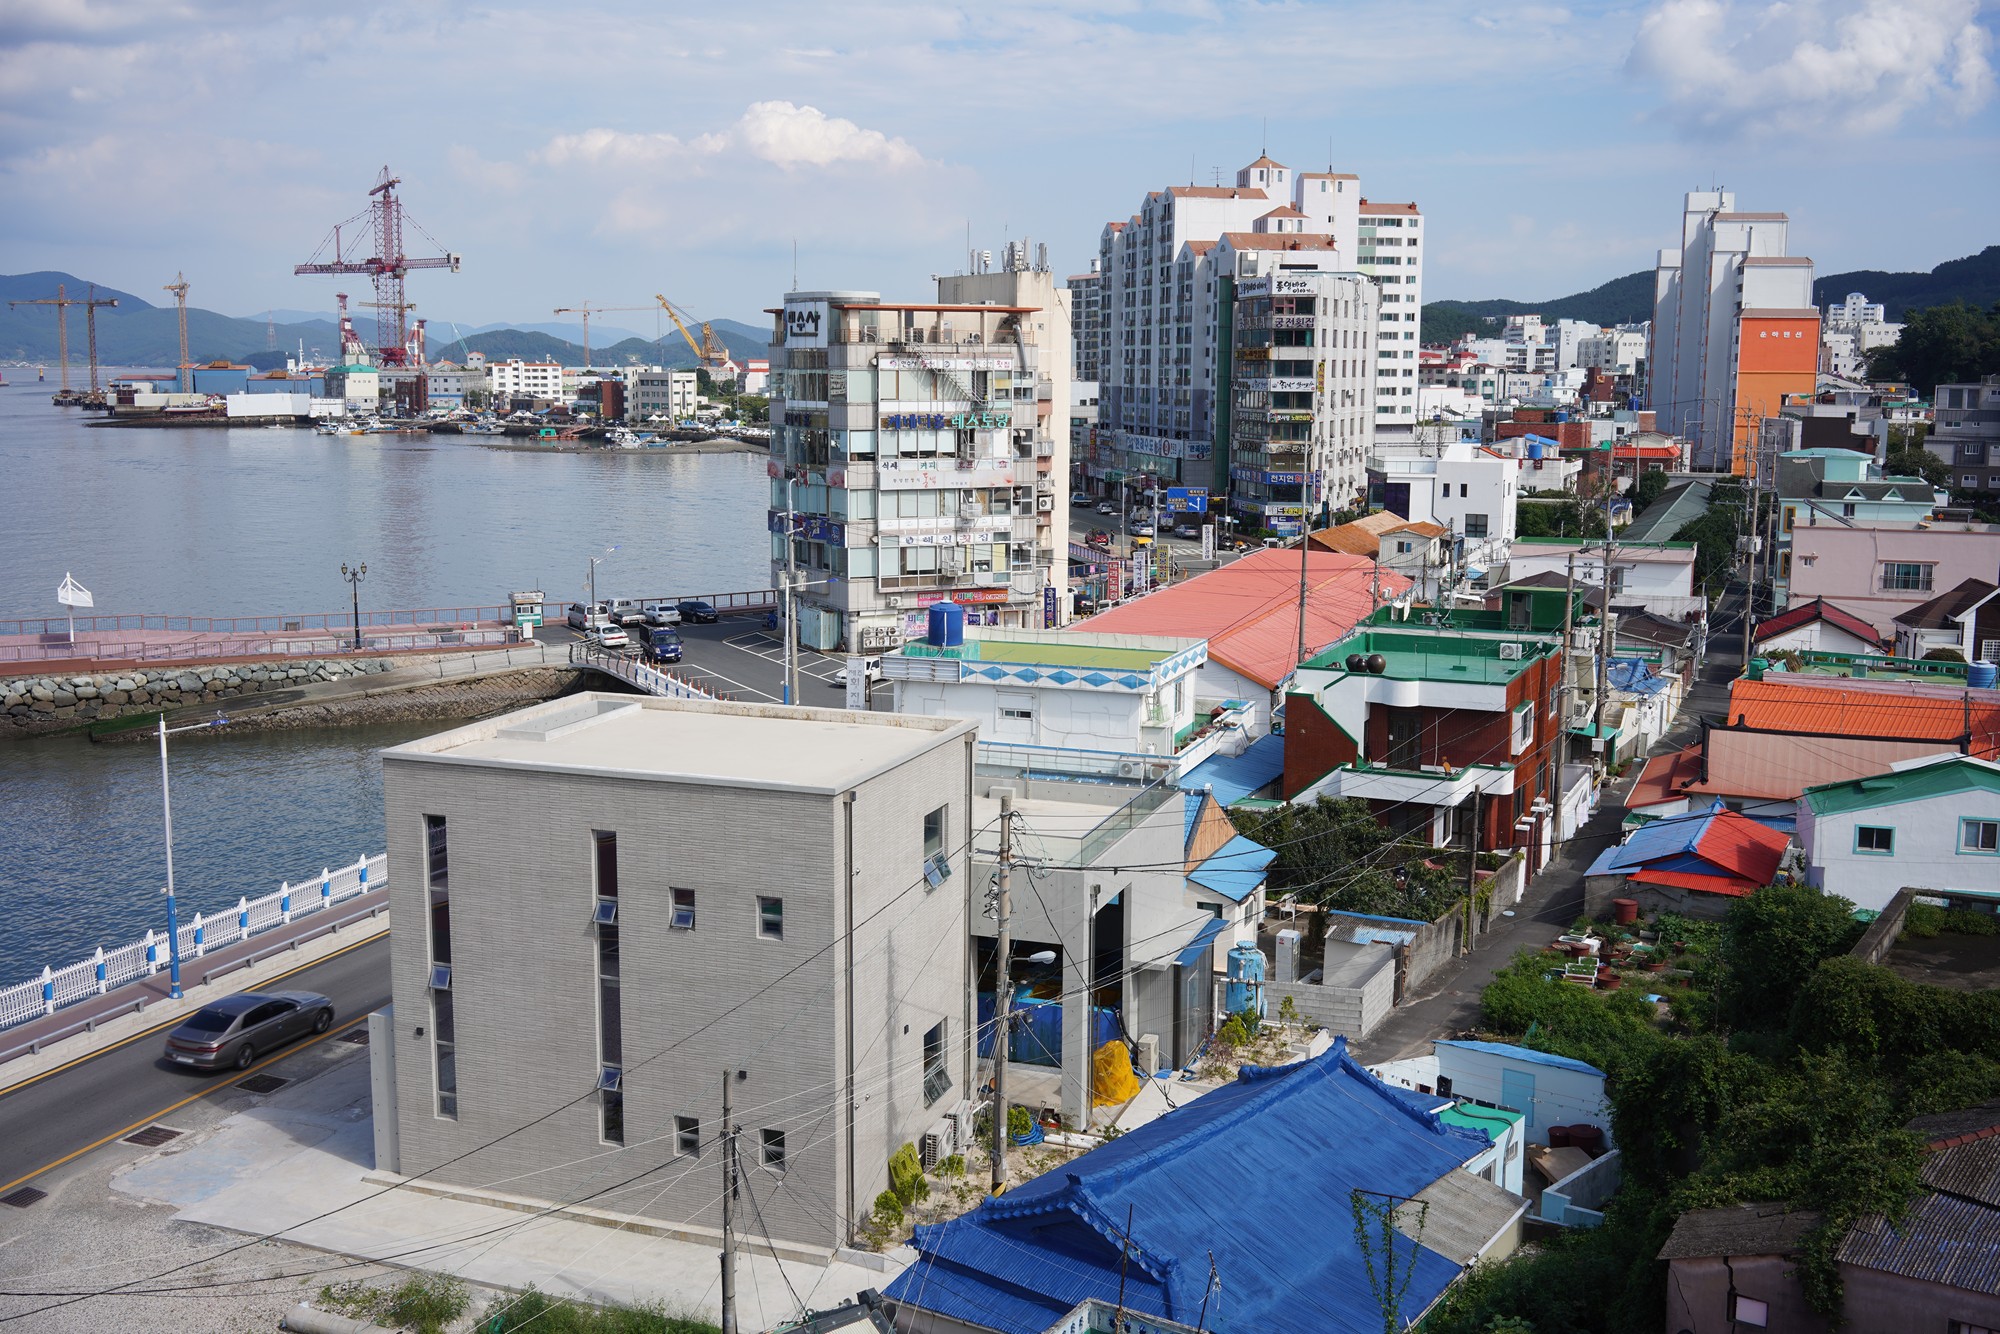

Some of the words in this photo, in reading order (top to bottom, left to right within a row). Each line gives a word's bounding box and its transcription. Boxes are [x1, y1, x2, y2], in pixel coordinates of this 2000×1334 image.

[1275, 317, 1315, 328] 궁전횟집
[951, 412, 1009, 430] 레스토랑
[920, 460, 937, 470] 커피
